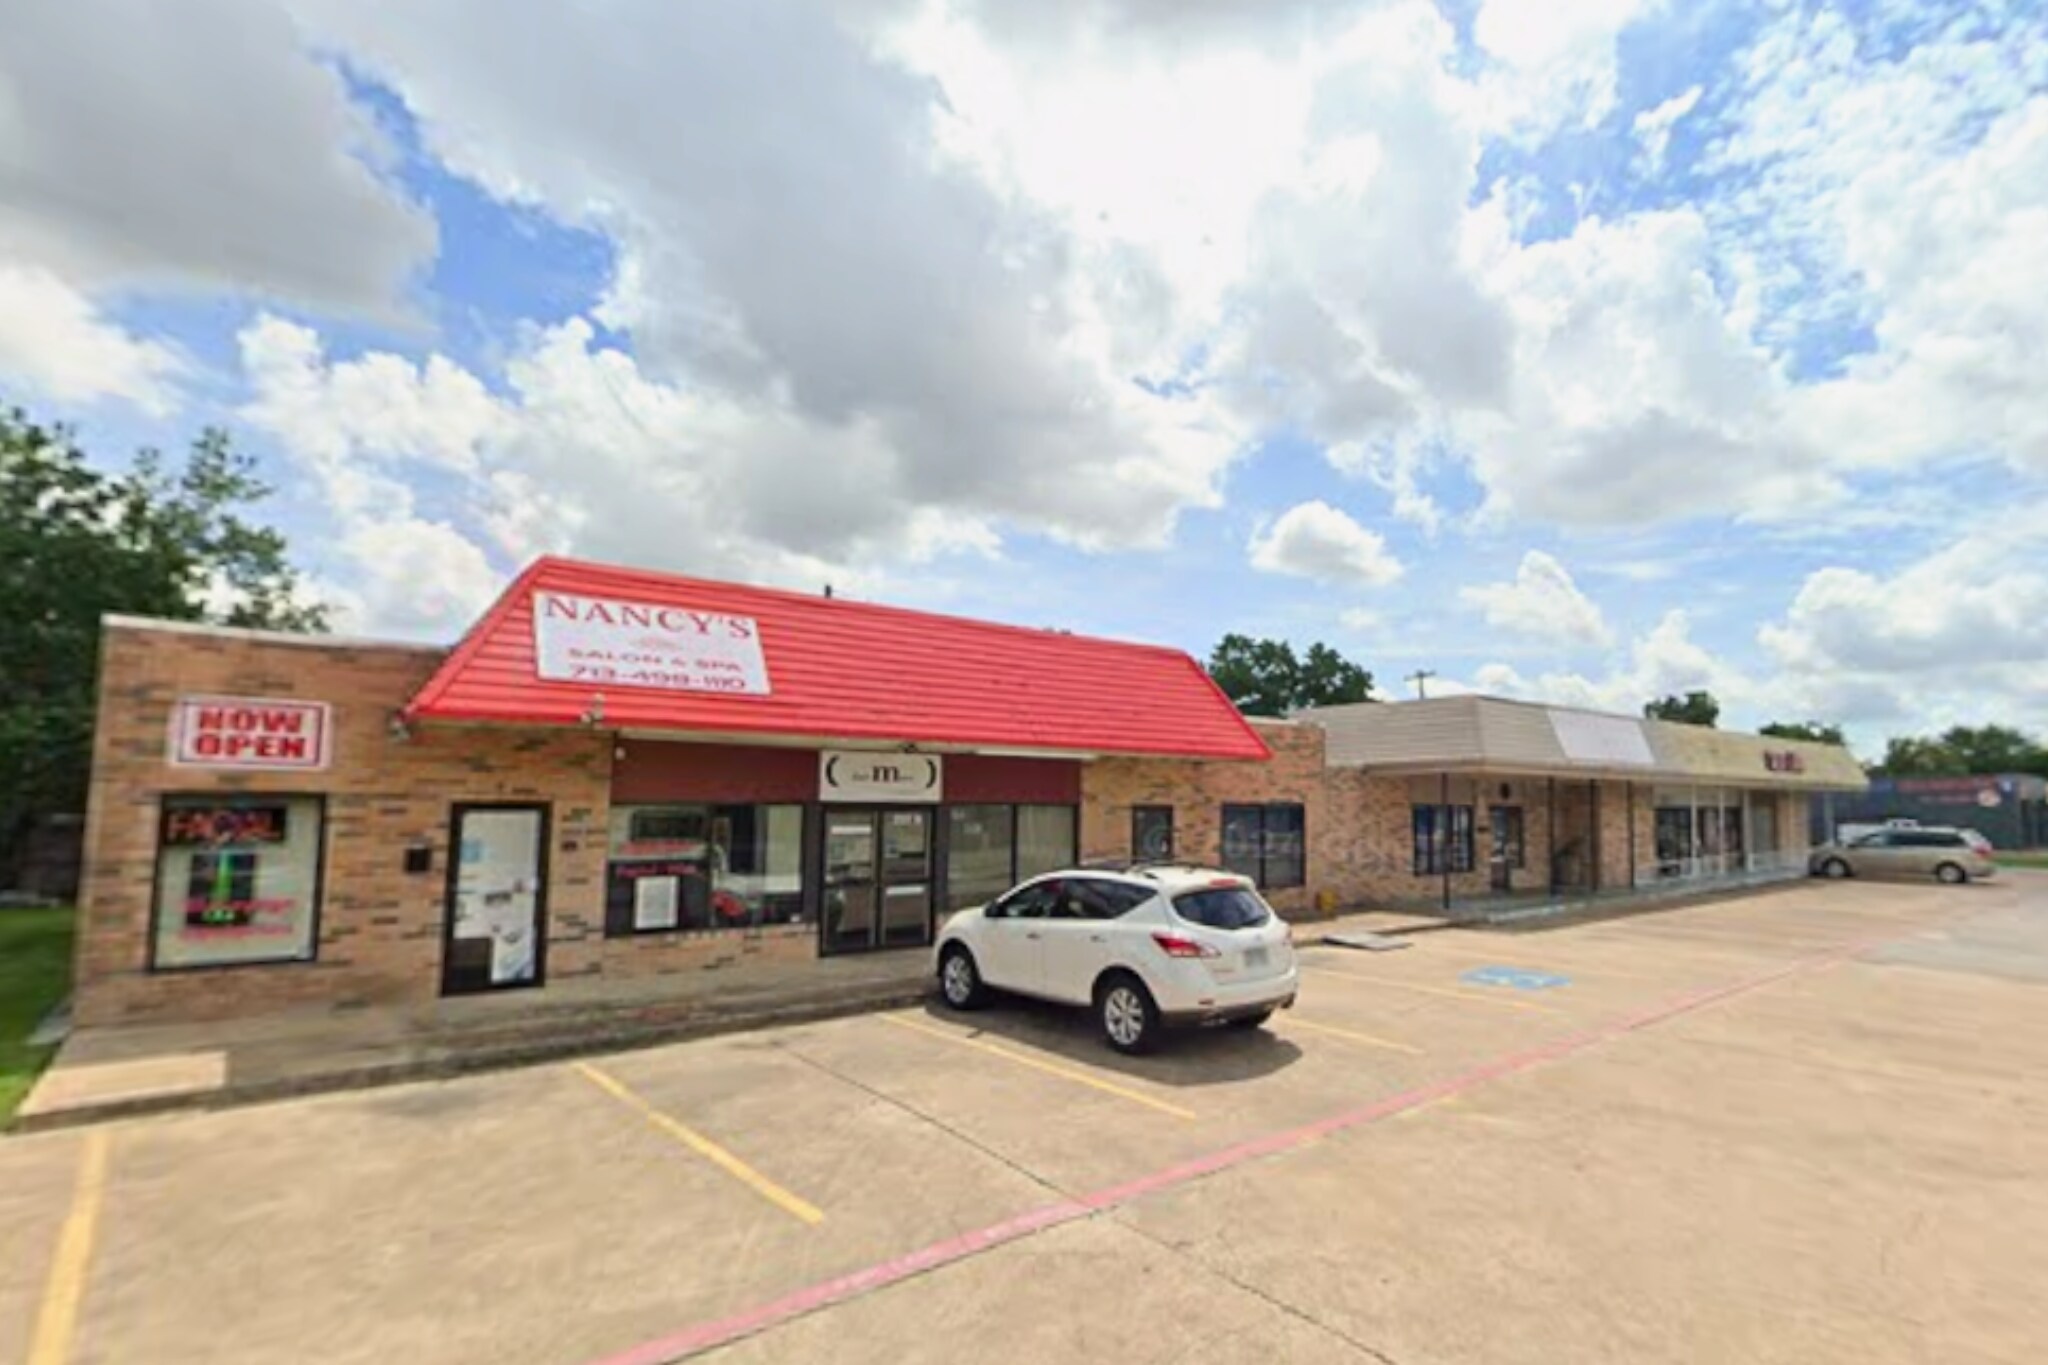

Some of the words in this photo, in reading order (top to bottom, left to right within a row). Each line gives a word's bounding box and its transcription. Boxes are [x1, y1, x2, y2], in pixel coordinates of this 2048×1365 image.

[546, 596, 752, 641] NANCY'S
[568, 648, 663, 666] SALON
[694, 658, 742, 673] SPA
[198, 707, 303, 734] NOW
[195, 733, 306, 758] OPEN
